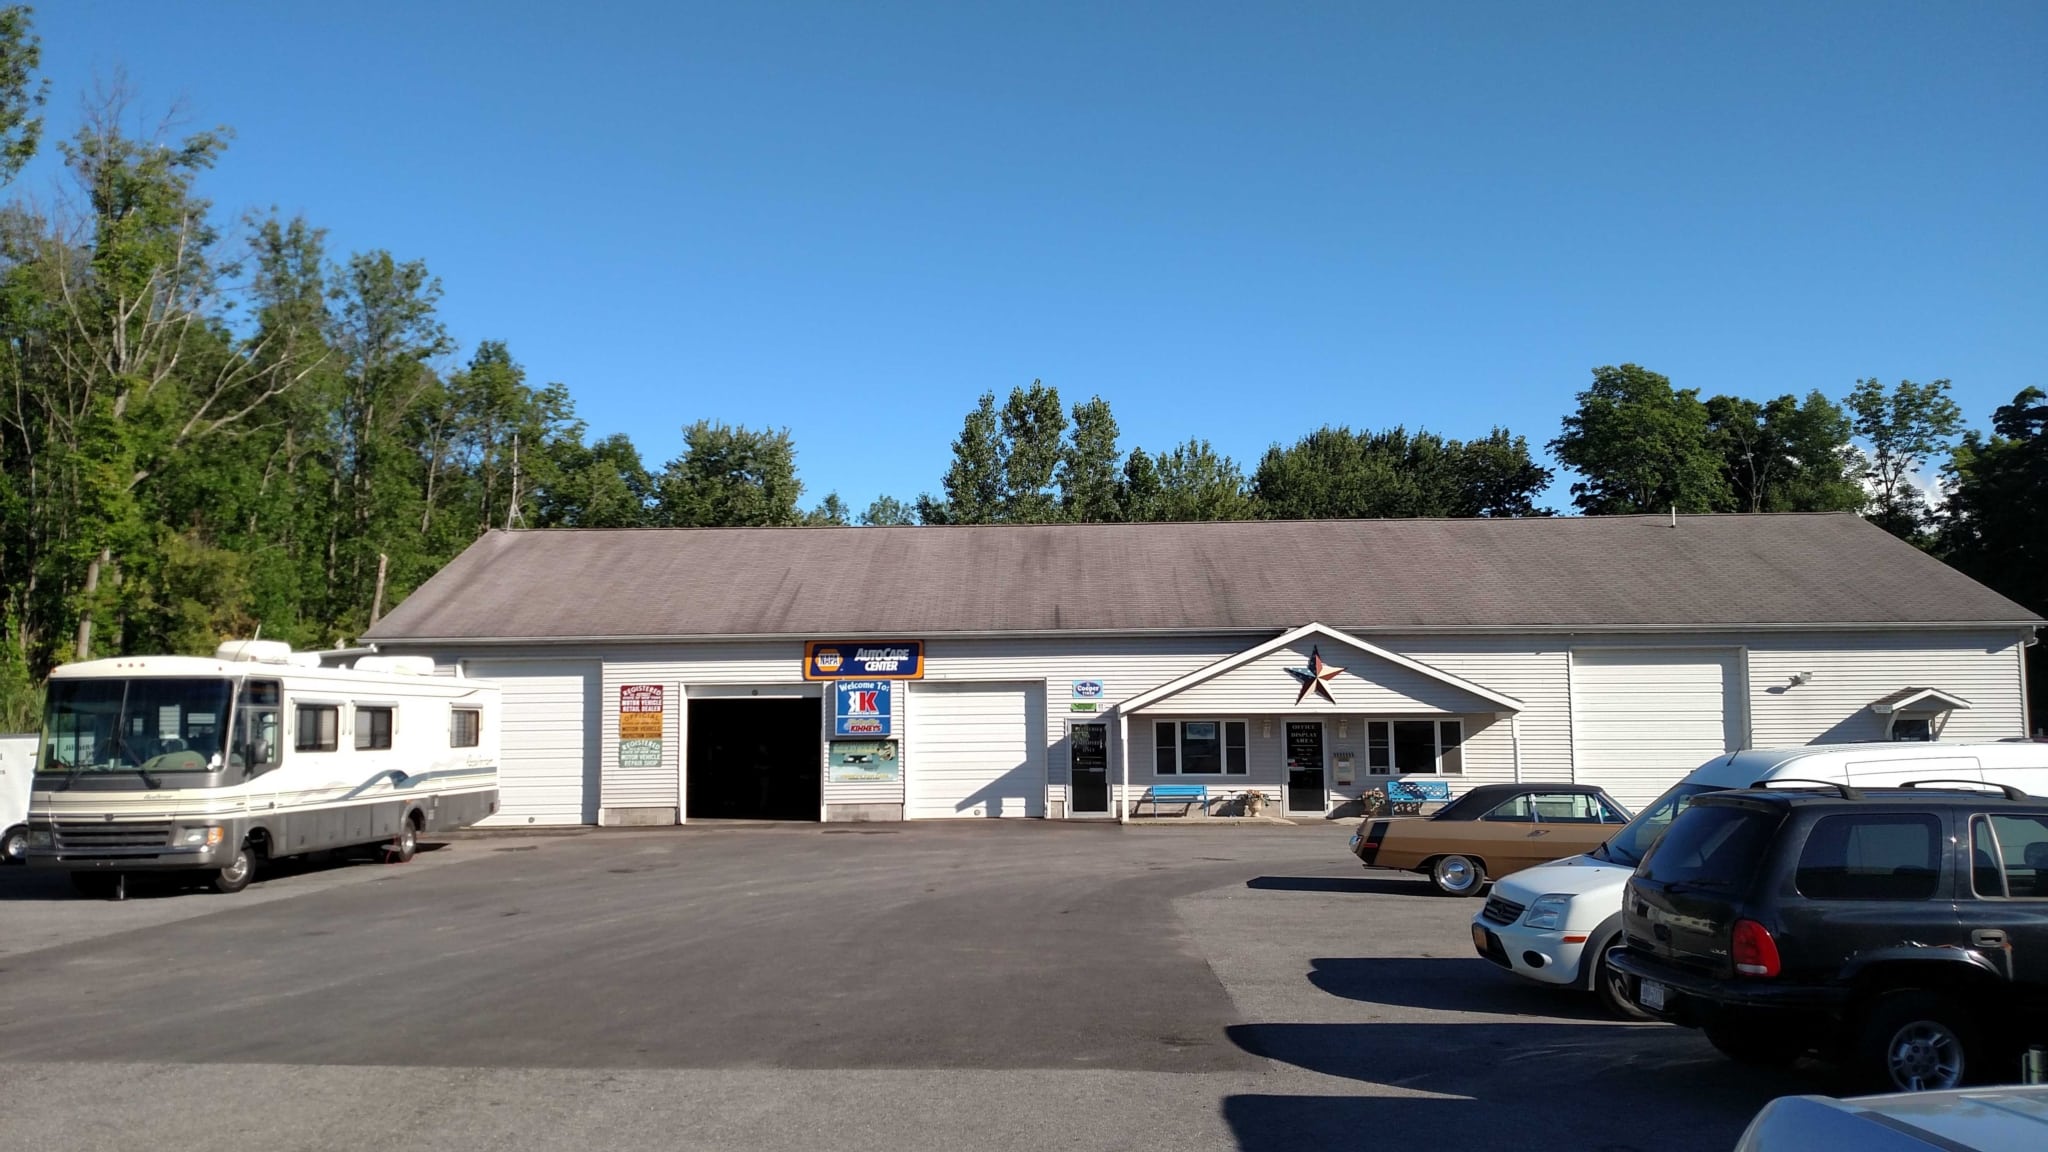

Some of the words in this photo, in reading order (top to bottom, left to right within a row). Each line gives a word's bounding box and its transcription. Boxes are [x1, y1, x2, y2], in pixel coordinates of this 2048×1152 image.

[820, 653, 839, 664] NAPA
[864, 661, 898, 671] CENTER
[622, 686, 661, 696] REGISTERED
[839, 682, 874, 692] Welcome
[624, 713, 659, 721] OFFICIAL
[622, 740, 660, 750] REGISTERED
